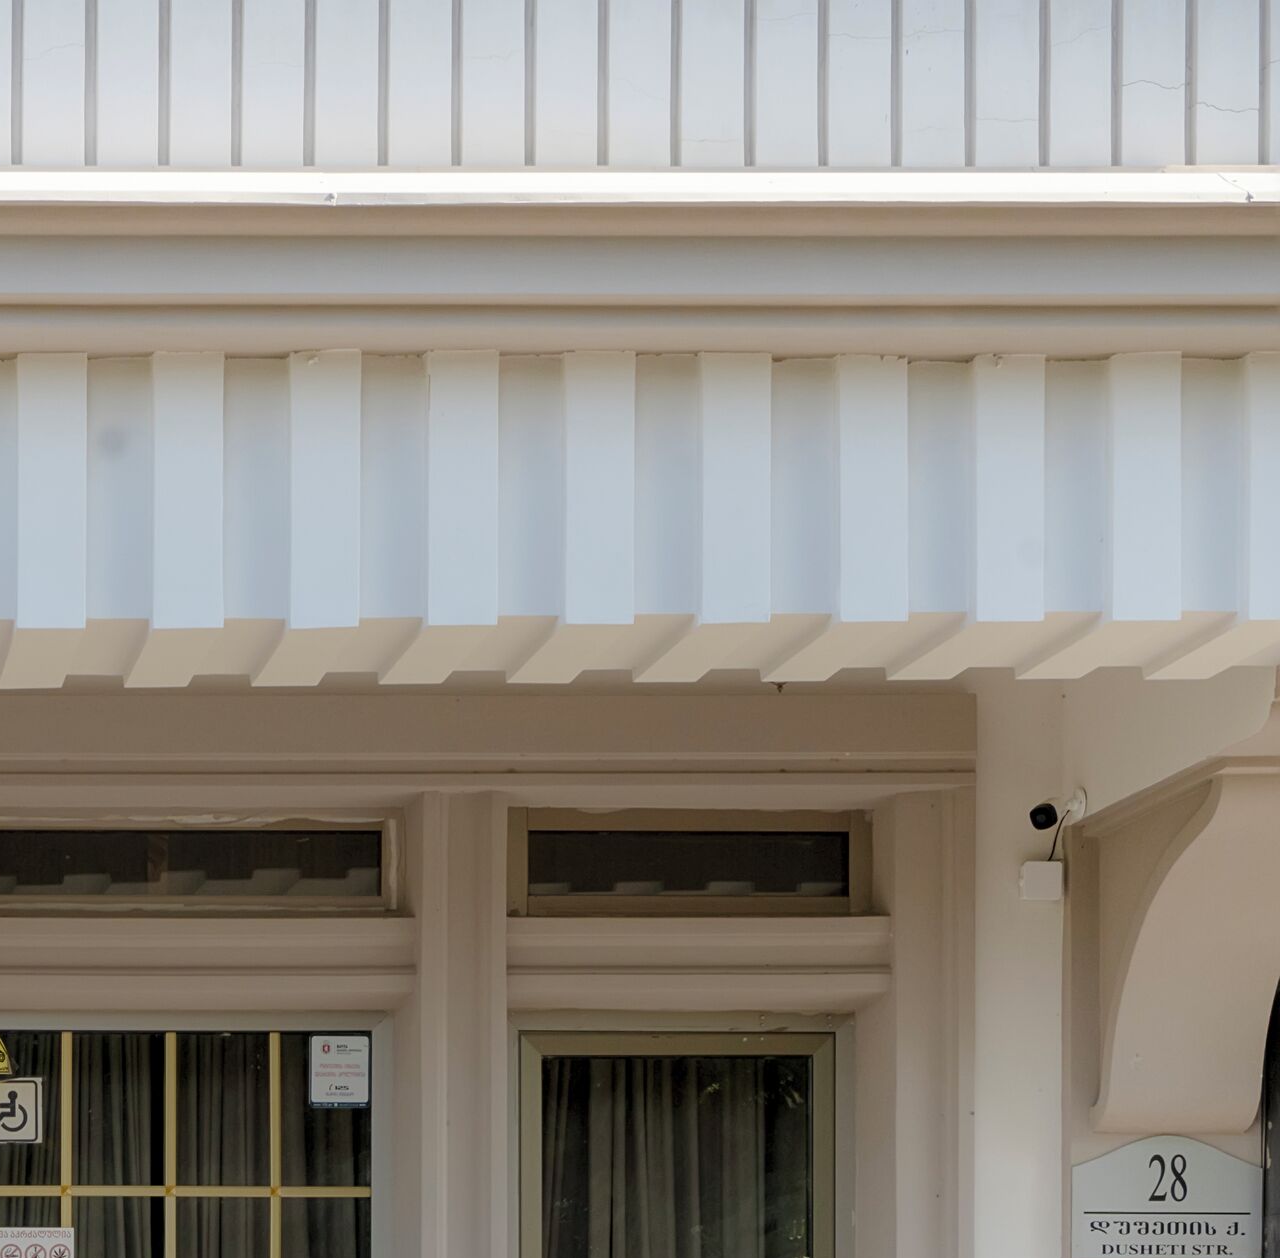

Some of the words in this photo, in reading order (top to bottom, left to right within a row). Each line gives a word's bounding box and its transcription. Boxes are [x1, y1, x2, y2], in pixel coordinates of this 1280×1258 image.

[1148, 1154, 1188, 1202] 28
[1090, 1221, 1216, 1236] დუშეთის
[1226, 1221, 1246, 1236] ქ.
[1101, 1244, 1185, 1256] DUSHETI
[1191, 1244, 1233, 1256] STR.
